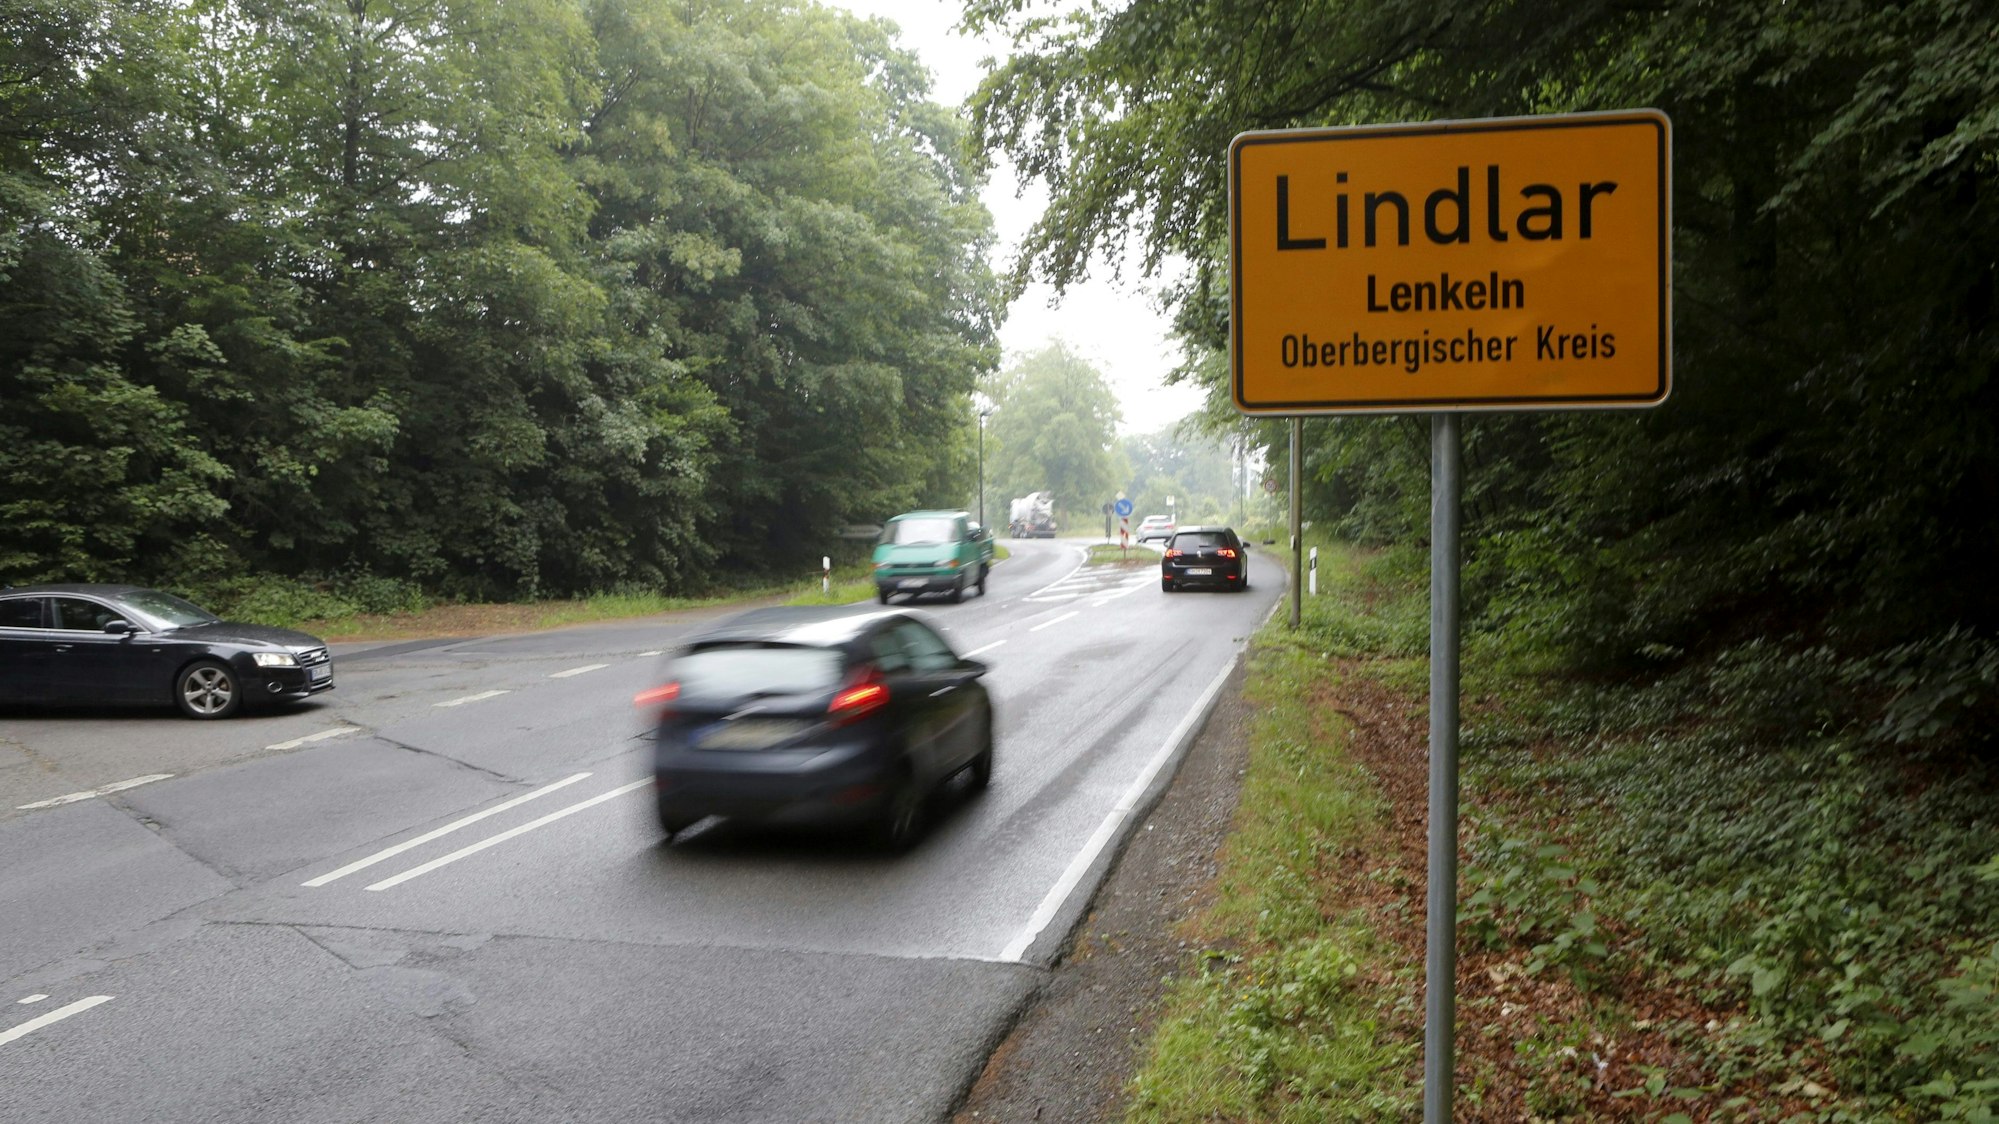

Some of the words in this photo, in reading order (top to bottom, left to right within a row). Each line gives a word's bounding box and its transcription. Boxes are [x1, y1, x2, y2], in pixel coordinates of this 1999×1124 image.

[1277, 165, 1618, 251] Lindlar
[1367, 271, 1524, 313] Lenkeln
[1281, 327, 1518, 374] Oberbergischer
[1537, 323, 1616, 361] Kreis
